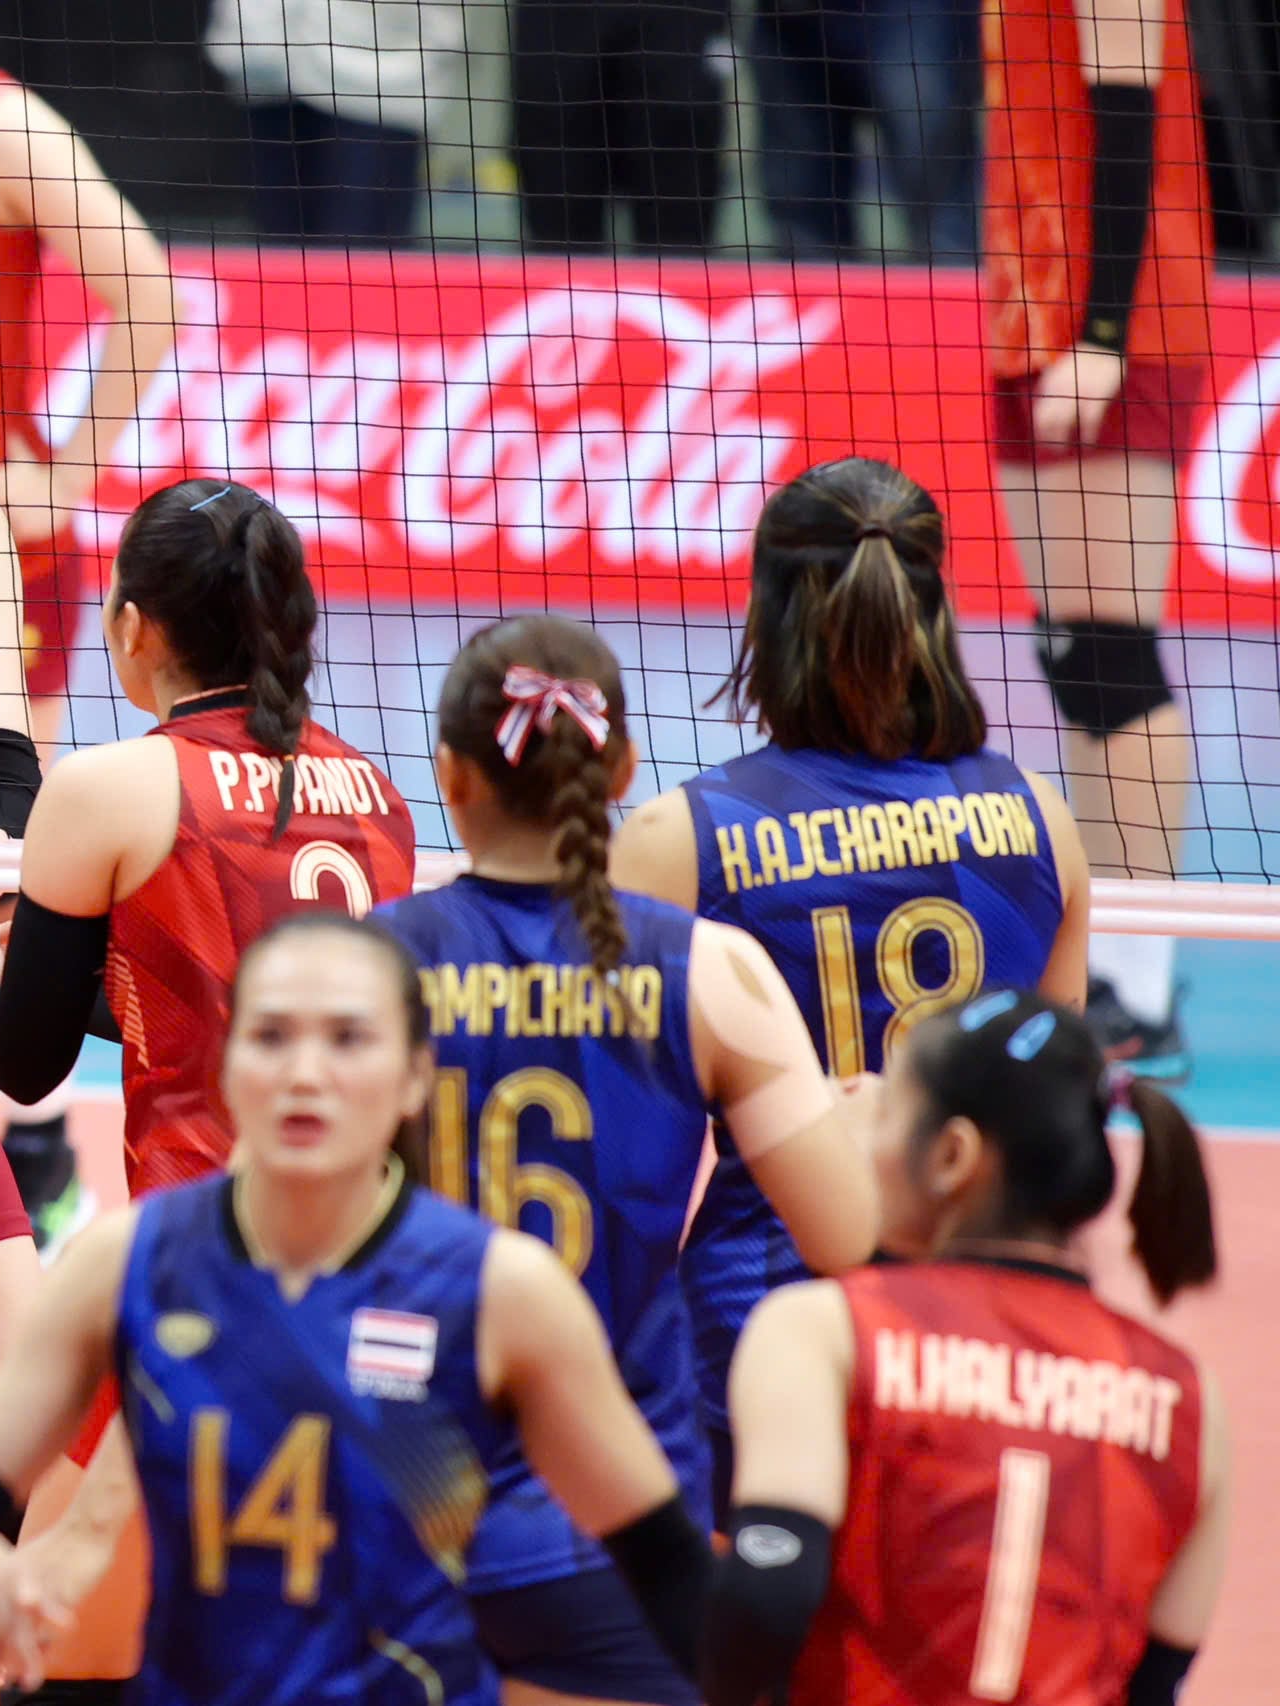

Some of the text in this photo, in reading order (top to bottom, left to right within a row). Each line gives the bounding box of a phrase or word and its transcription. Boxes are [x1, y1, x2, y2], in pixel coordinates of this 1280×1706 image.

[811, 896, 984, 1076] 18
[430, 1066, 593, 1278] 16
[189, 1408, 337, 1606] 14
[970, 1447, 1051, 1702] 1
